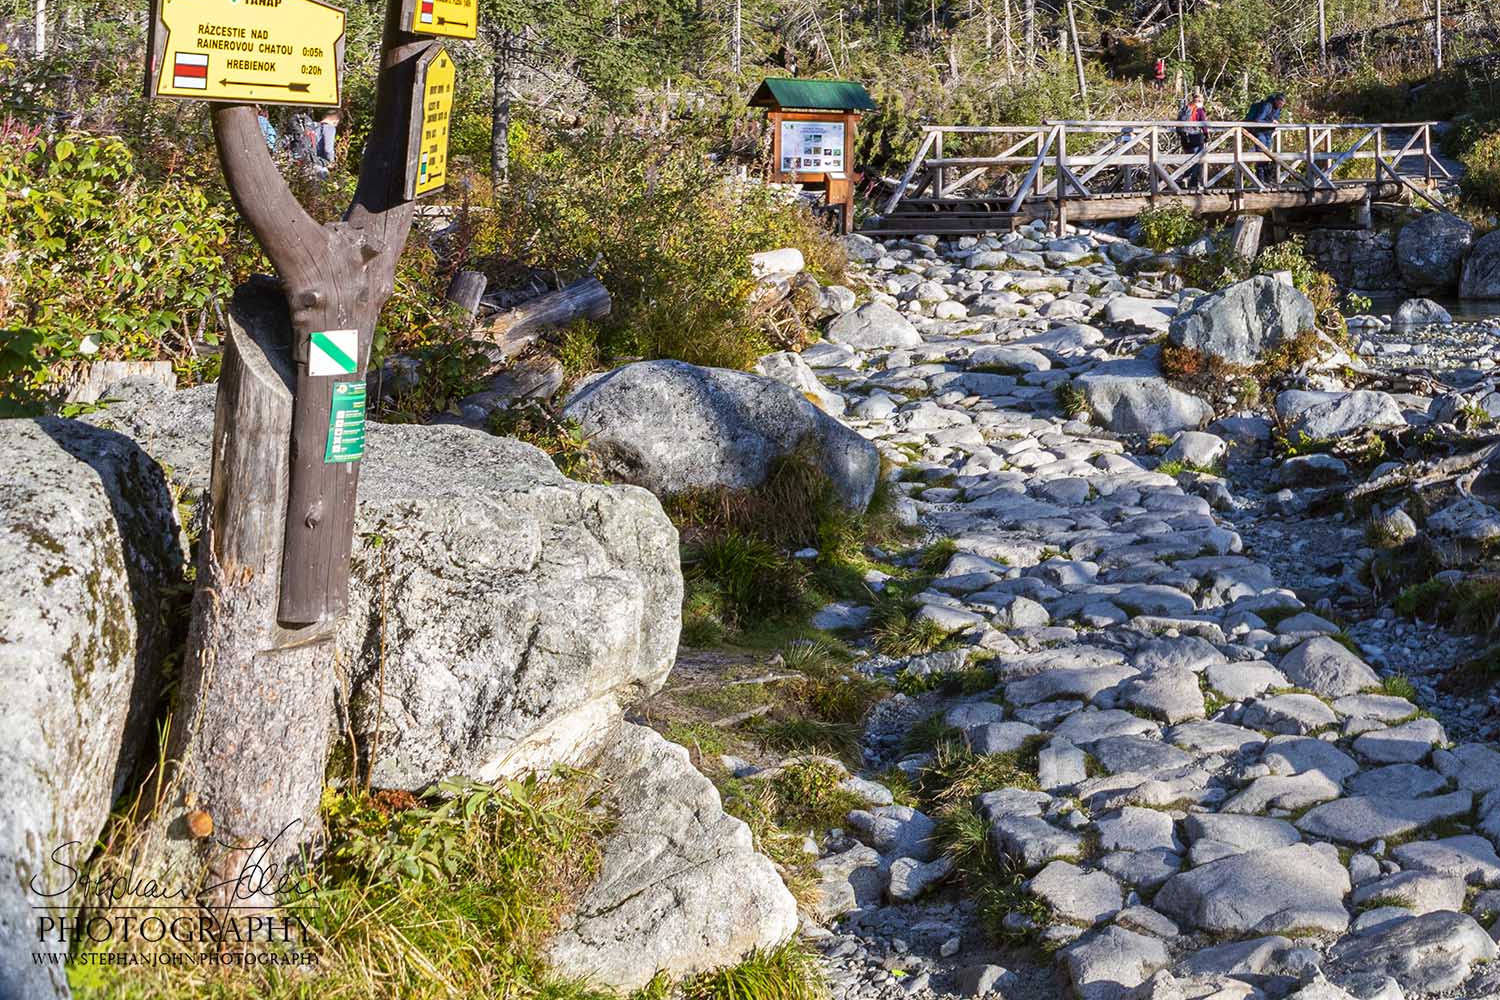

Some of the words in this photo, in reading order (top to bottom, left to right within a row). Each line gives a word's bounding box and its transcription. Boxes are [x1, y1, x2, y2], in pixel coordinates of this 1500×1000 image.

[198, 22, 246, 39] RÁZCESTIE
[251, 29, 269, 40] NAD
[196, 38, 254, 53] RAINEROVOU
[258, 43, 293, 56] CHATOU
[302, 46, 324, 58] 0:05h
[226, 59, 276, 72] HREBIENOK
[301, 65, 322, 75] 0:20h
